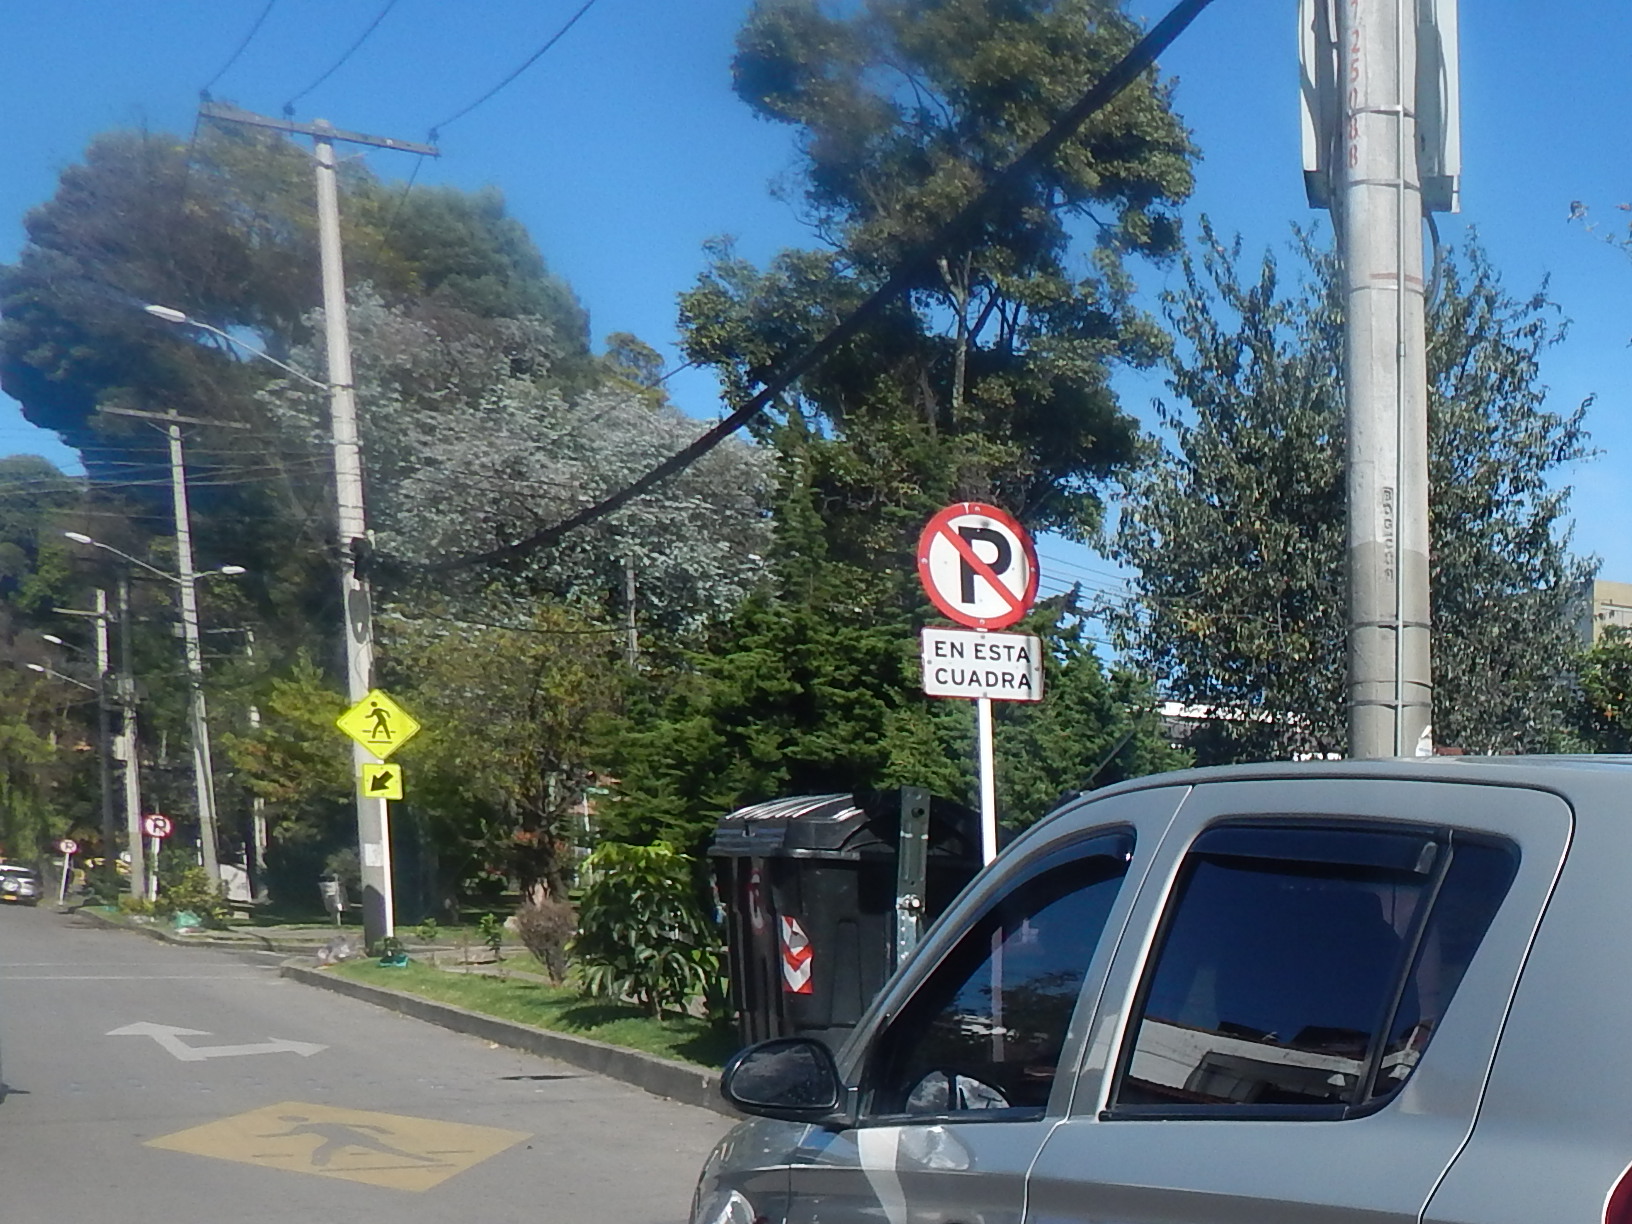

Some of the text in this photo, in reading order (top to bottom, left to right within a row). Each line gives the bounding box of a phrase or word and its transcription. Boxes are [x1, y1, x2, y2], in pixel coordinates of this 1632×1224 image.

[958, 526, 1012, 604] P
[934, 640, 1031, 663] EN ESTA
[935, 667, 1032, 690] CUADRA
